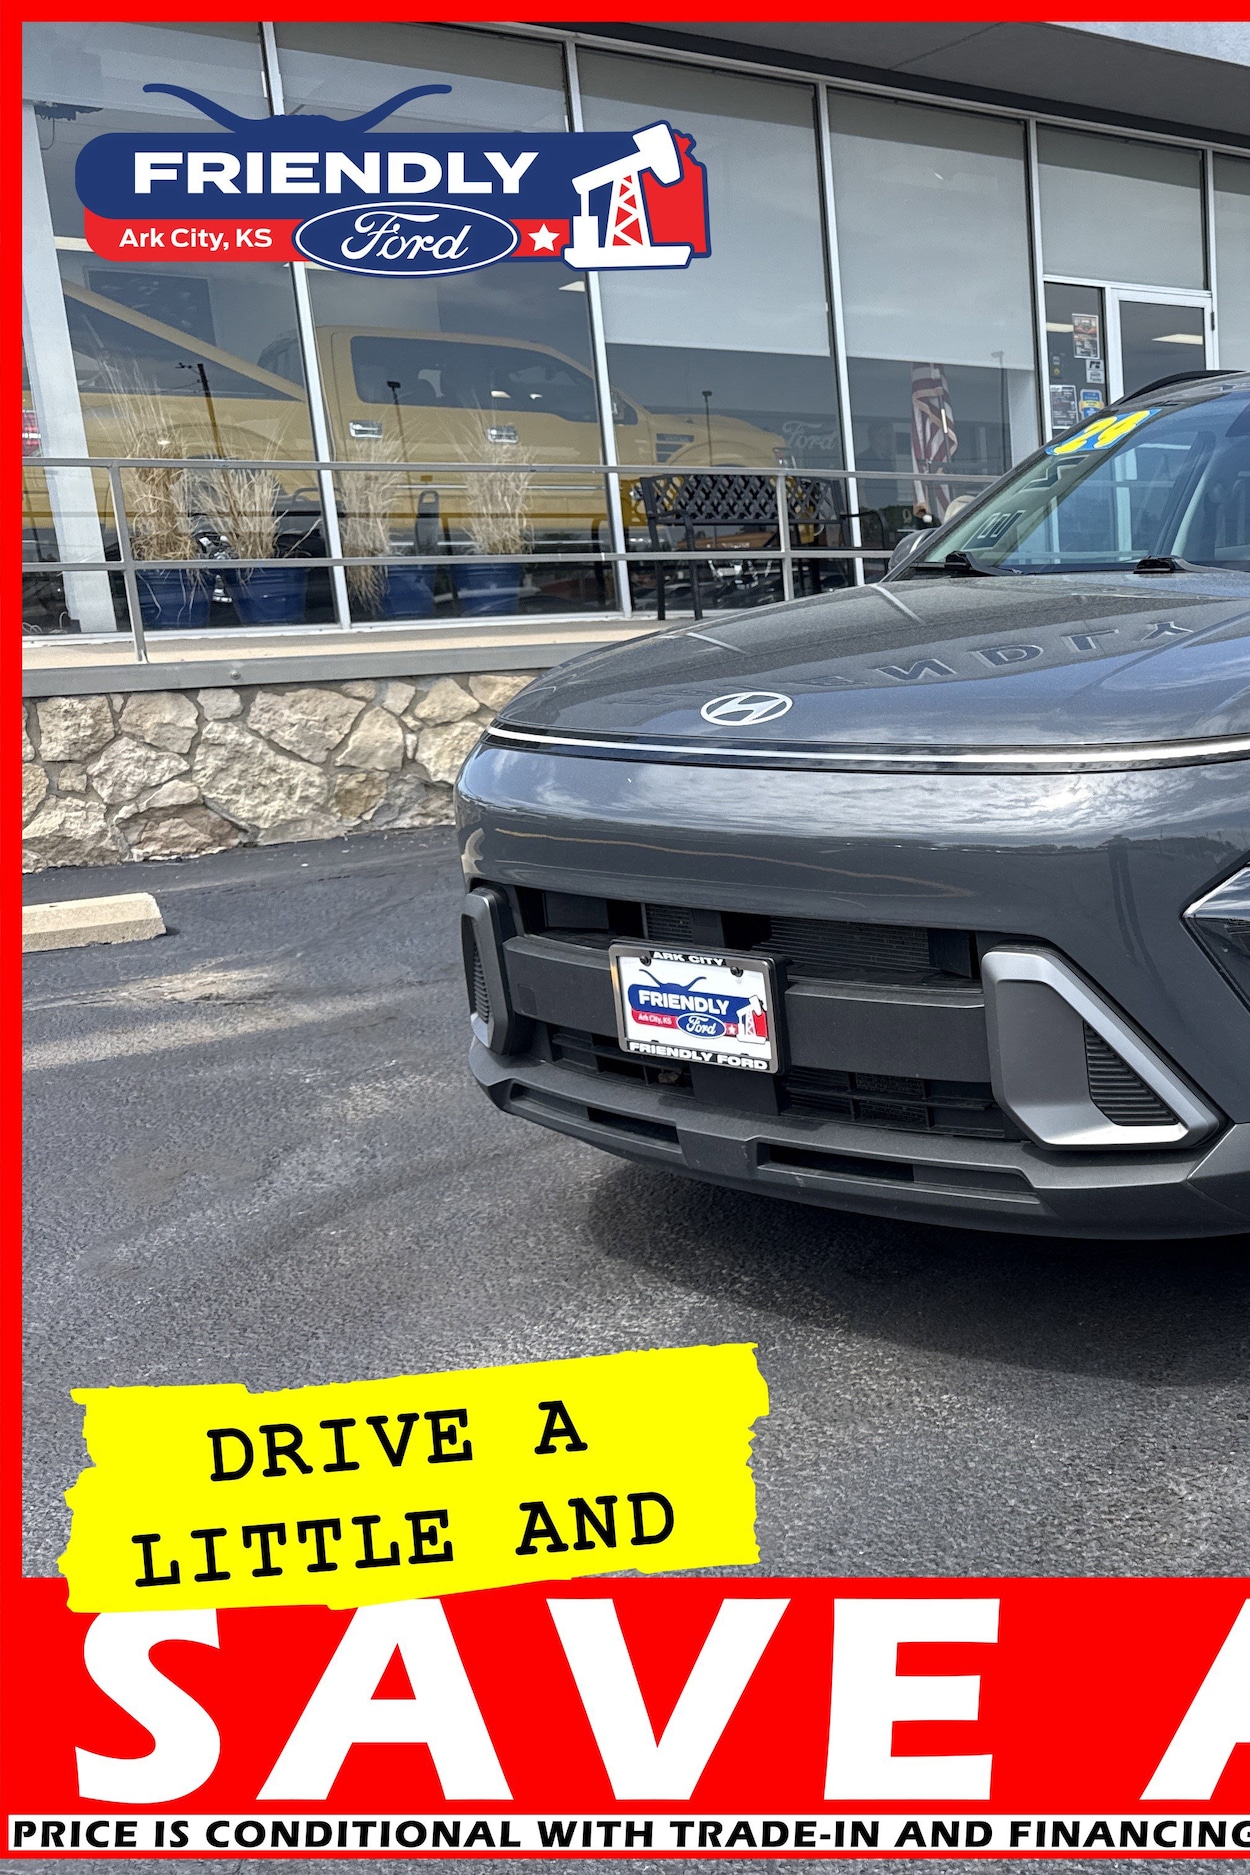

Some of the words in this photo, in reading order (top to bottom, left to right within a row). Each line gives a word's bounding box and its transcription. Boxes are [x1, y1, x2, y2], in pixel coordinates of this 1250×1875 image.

[653, 951, 685, 962] ARK
[688, 955, 724, 967] CITY
[638, 989, 730, 1015] FRIENDLY
[686, 1015, 717, 1036] Ford
[629, 1042, 713, 1063] FRIENDLY
[717, 1054, 768, 1070] FORD
